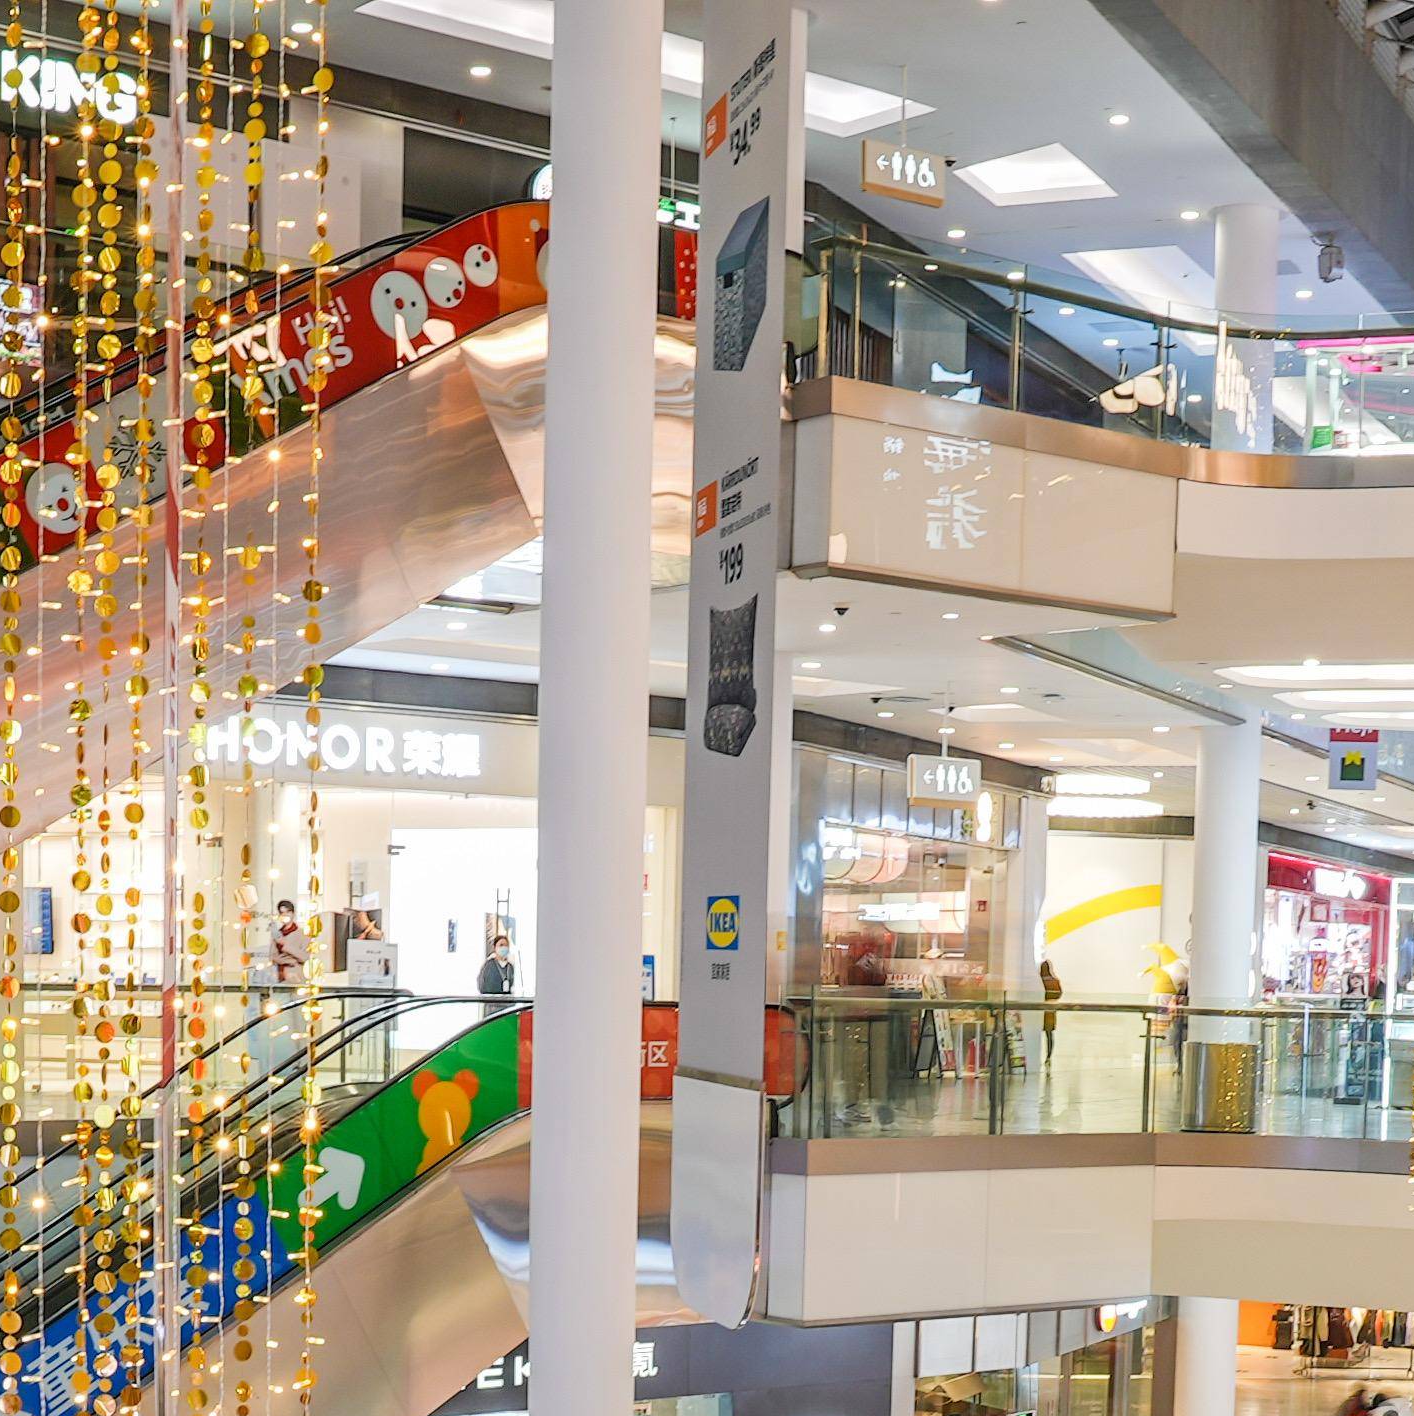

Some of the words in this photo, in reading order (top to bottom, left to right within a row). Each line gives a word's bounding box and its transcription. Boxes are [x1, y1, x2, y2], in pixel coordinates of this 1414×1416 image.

[0, 50, 139, 125] KING
[291, 296, 352, 345] Hj!
[205, 715, 396, 773] HONOR
[402, 730, 481, 778] 荣耀
[709, 913, 737, 934] IKEA
[633, 1341, 659, 1378] 氪
